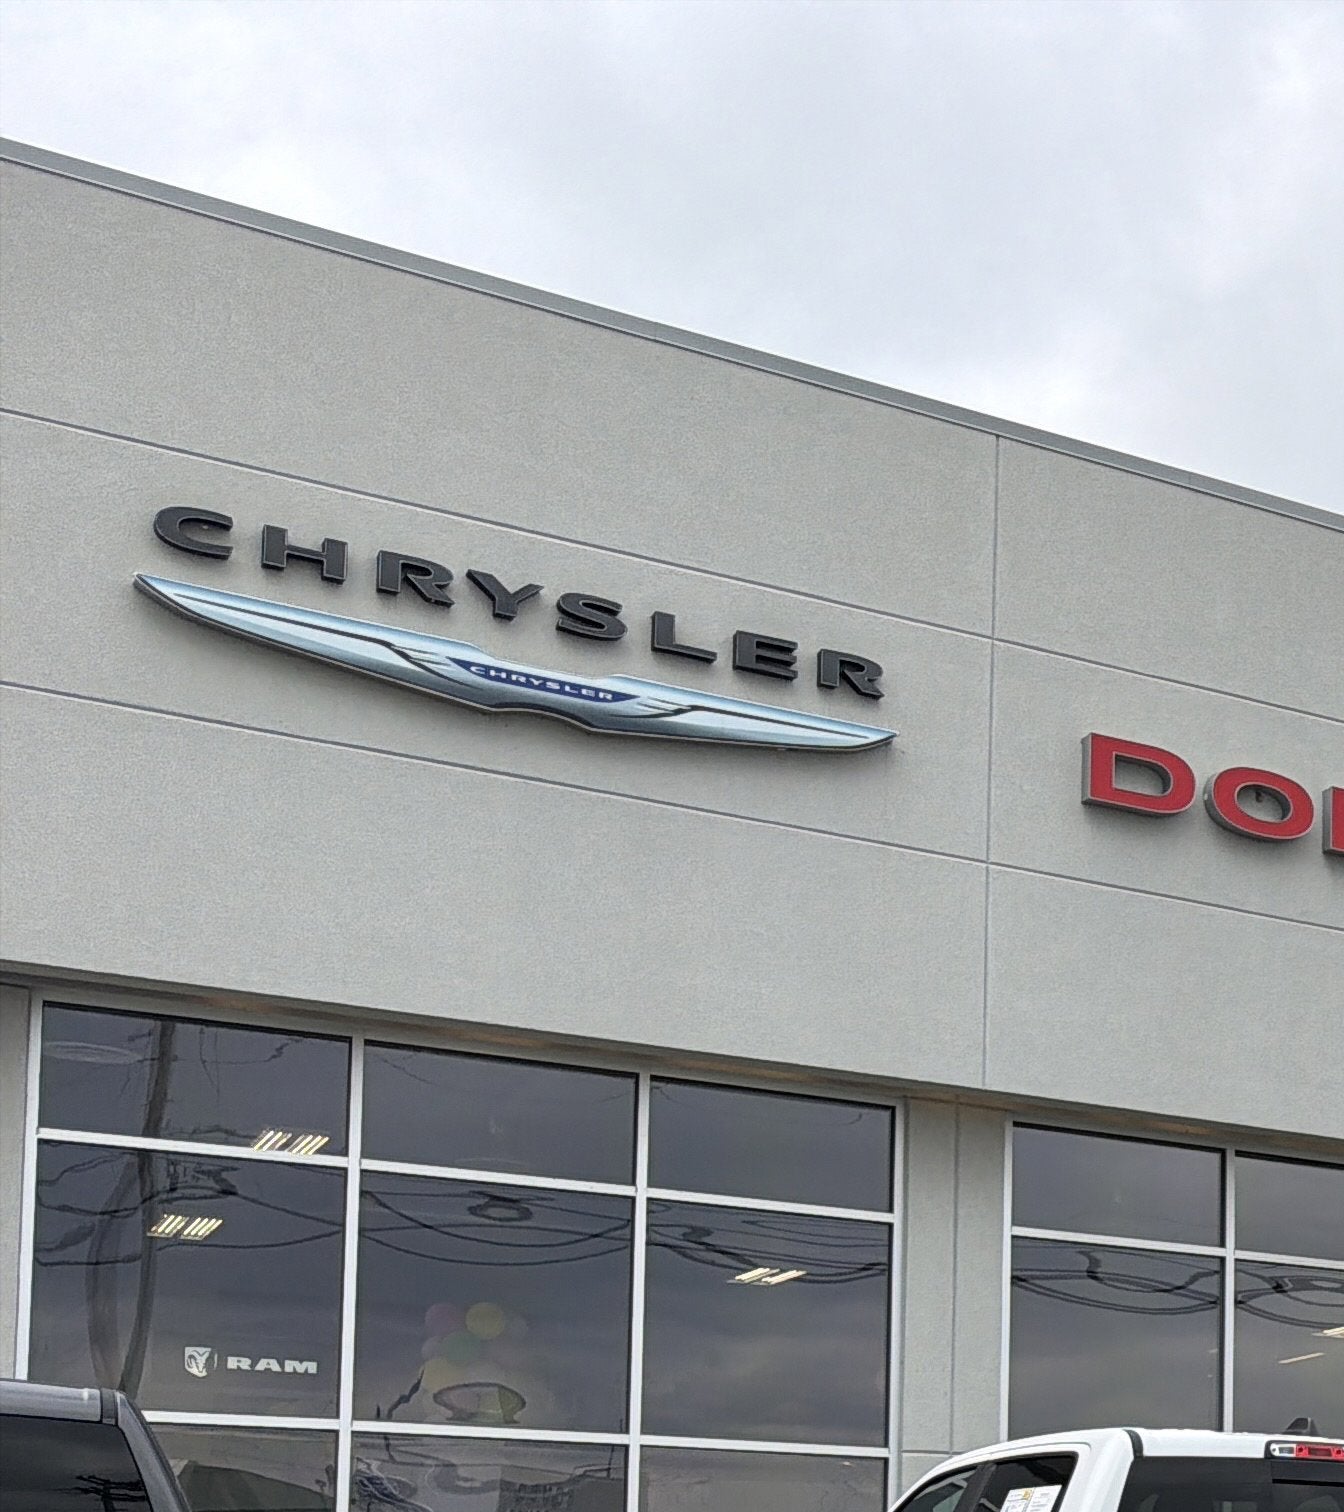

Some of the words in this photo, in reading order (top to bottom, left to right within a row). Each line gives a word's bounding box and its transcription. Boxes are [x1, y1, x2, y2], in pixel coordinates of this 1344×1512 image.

[153, 505, 886, 699] CHRYSLER
[470, 665, 613, 700] CHRYSLER
[226, 1356, 318, 1374] RAM
